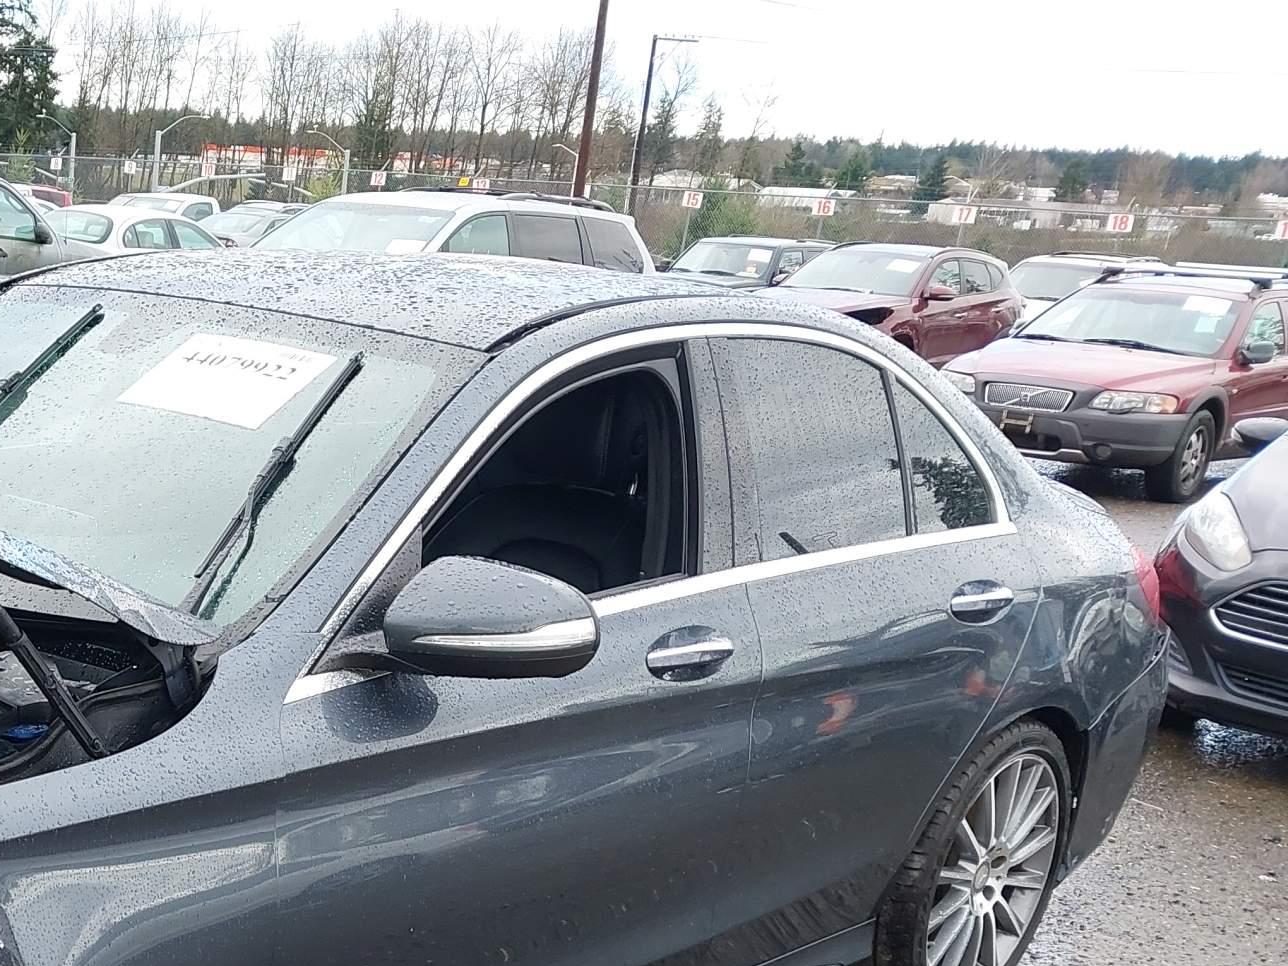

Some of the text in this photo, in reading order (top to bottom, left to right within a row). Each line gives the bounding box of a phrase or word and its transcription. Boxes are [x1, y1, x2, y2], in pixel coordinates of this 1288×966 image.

[373, 172, 384, 185] 12
[686, 193, 700, 206] 15
[817, 201, 831, 214] 16
[958, 208, 972, 222] 17
[1112, 215, 1129, 230] 18
[182, 351, 297, 381] 44079922
